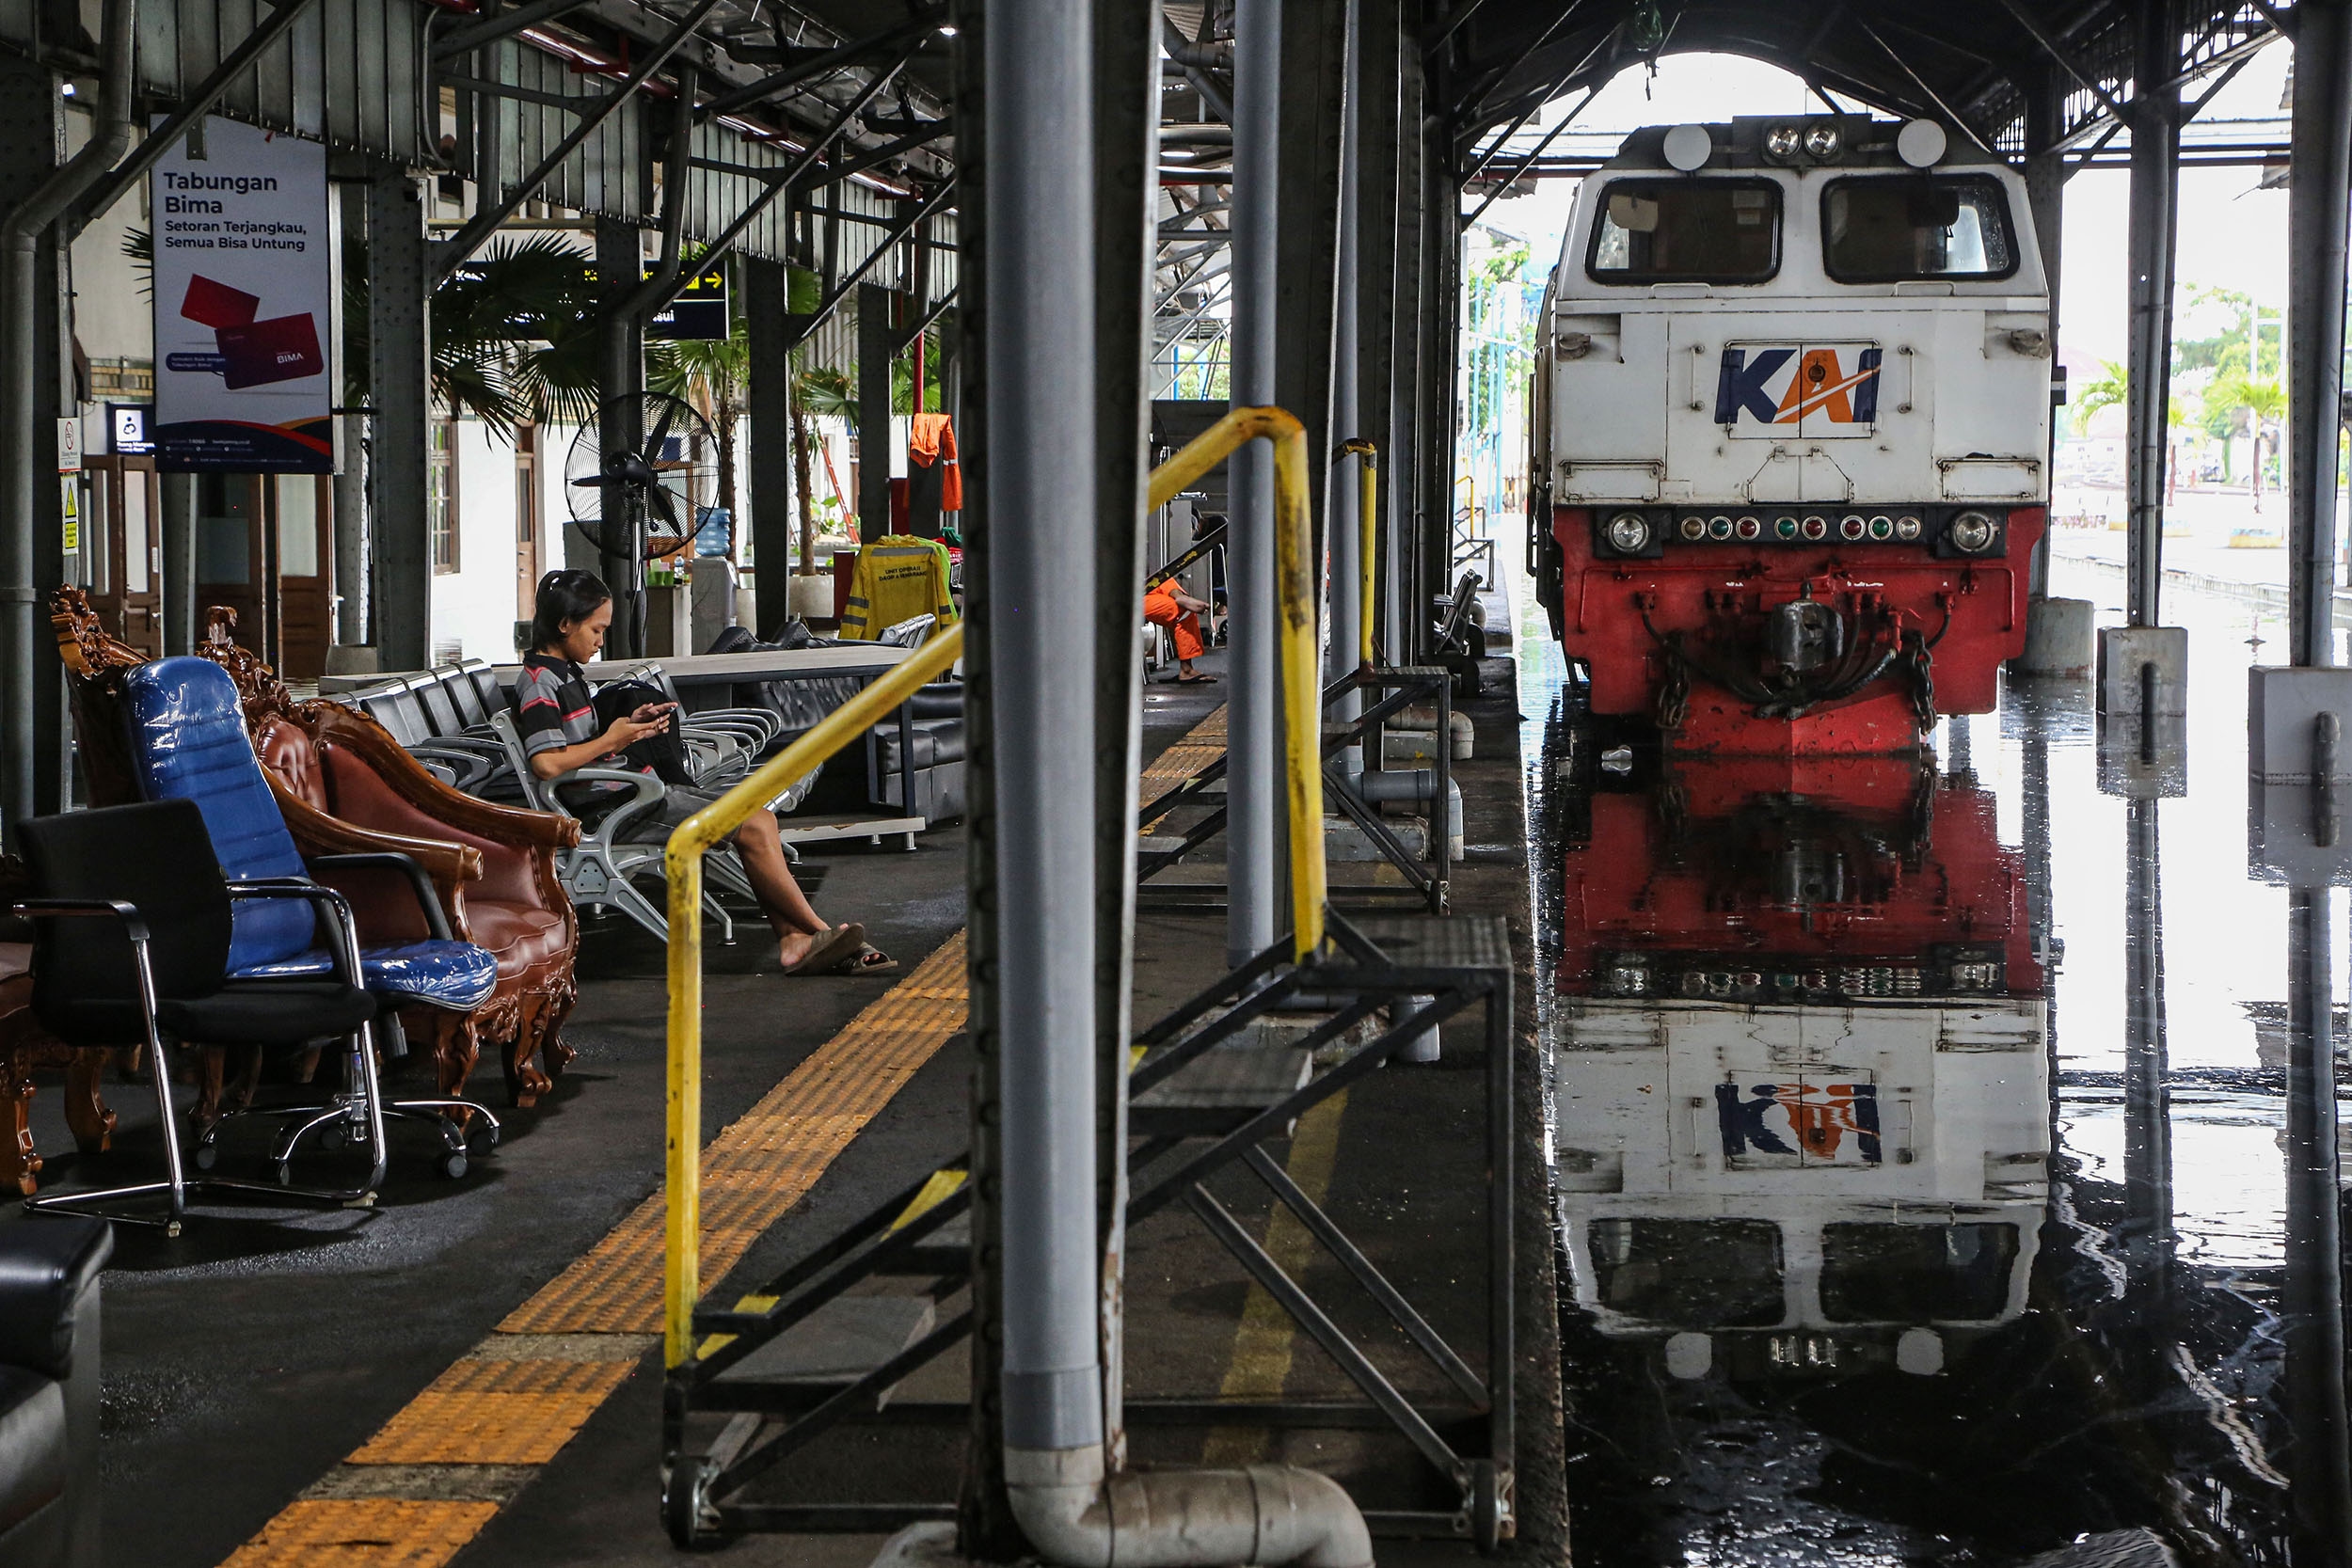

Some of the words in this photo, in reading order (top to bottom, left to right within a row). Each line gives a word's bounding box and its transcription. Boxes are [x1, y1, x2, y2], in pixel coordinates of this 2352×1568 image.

[164, 172, 278, 195] Tabungan
[165, 195, 223, 214] Bima
[165, 220, 220, 231] Setoran
[224, 221, 307, 235] Terjangkau,
[165, 237, 214, 248] Semua
[218, 237, 247, 248] Bisa
[252, 238, 305, 252] Untung
[277, 353, 303, 364] BIMA
[1714, 348, 1883, 423] KAI
